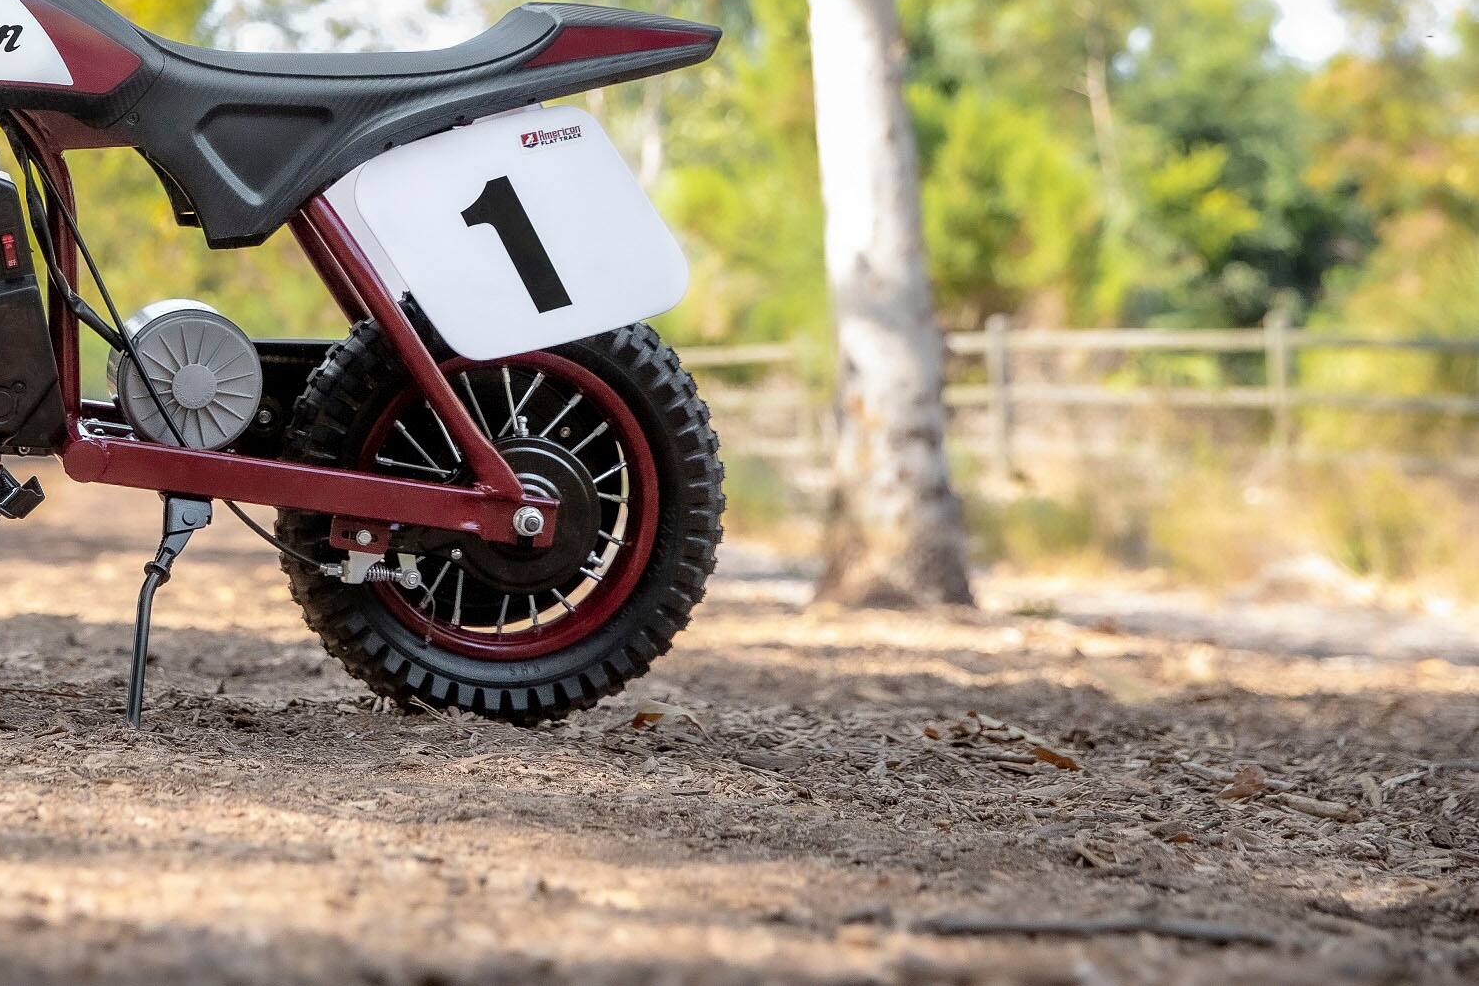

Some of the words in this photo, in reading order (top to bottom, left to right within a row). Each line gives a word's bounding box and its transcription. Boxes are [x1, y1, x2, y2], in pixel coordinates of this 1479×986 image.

[538, 125, 581, 140] American
[560, 133, 582, 142] TRACK
[460, 175, 573, 314] 1
